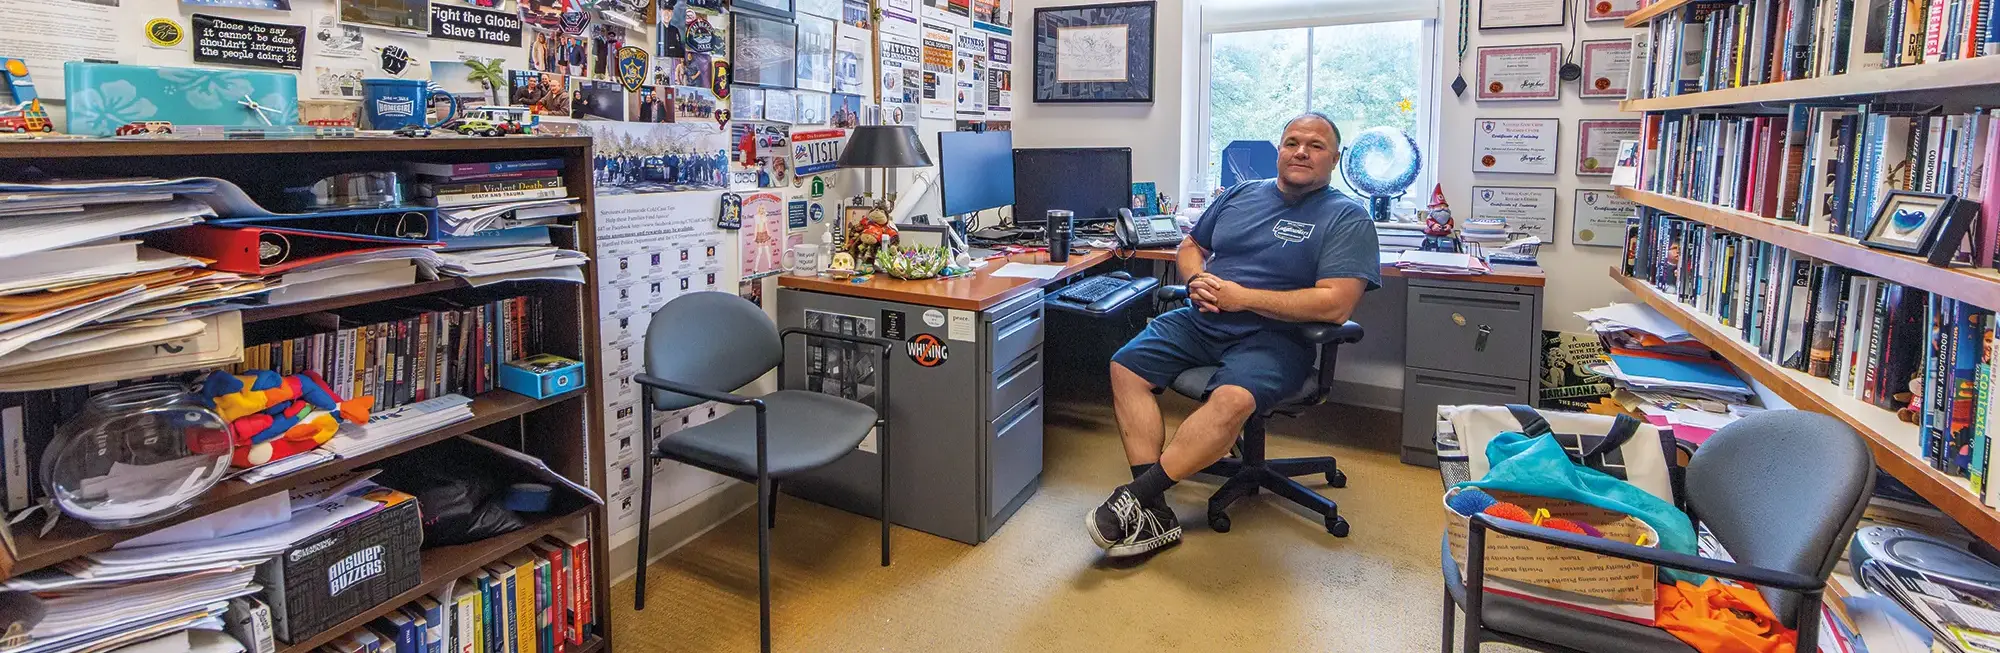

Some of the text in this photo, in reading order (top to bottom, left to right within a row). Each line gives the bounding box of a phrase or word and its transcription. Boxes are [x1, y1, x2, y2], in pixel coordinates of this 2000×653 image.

[432, 6, 520, 30] Fight the Global
[203, 28, 294, 44] it cannot be done
[212, 20, 286, 36] Those who say
[442, 23, 510, 42] Slave Trade
[1926, 0, 1944, 56] ENEMIES
[200, 38, 298, 54] shouldn't interrupt
[882, 40, 919, 57] WITNESS
[959, 35, 984, 47] WITNESS
[200, 48, 296, 64] the people doing it
[378, 102, 412, 114] HOMEGIRL
[808, 140, 838, 164] VISIT
[1850, 133, 1862, 204] CRIMINOLOGICAL THEORY
[484, 180, 544, 192] Violent Death
[814, 183, 818, 194] 1
[1870, 316, 1880, 354] MEXICAN
[1938, 332, 1948, 387] SOCIOLOGY
[1866, 357, 1875, 382] MAFIA
[1540, 386, 1597, 398] MARIJUANA
[1976, 373, 1989, 437] contexts
[330, 560, 382, 597] BUZZERS
